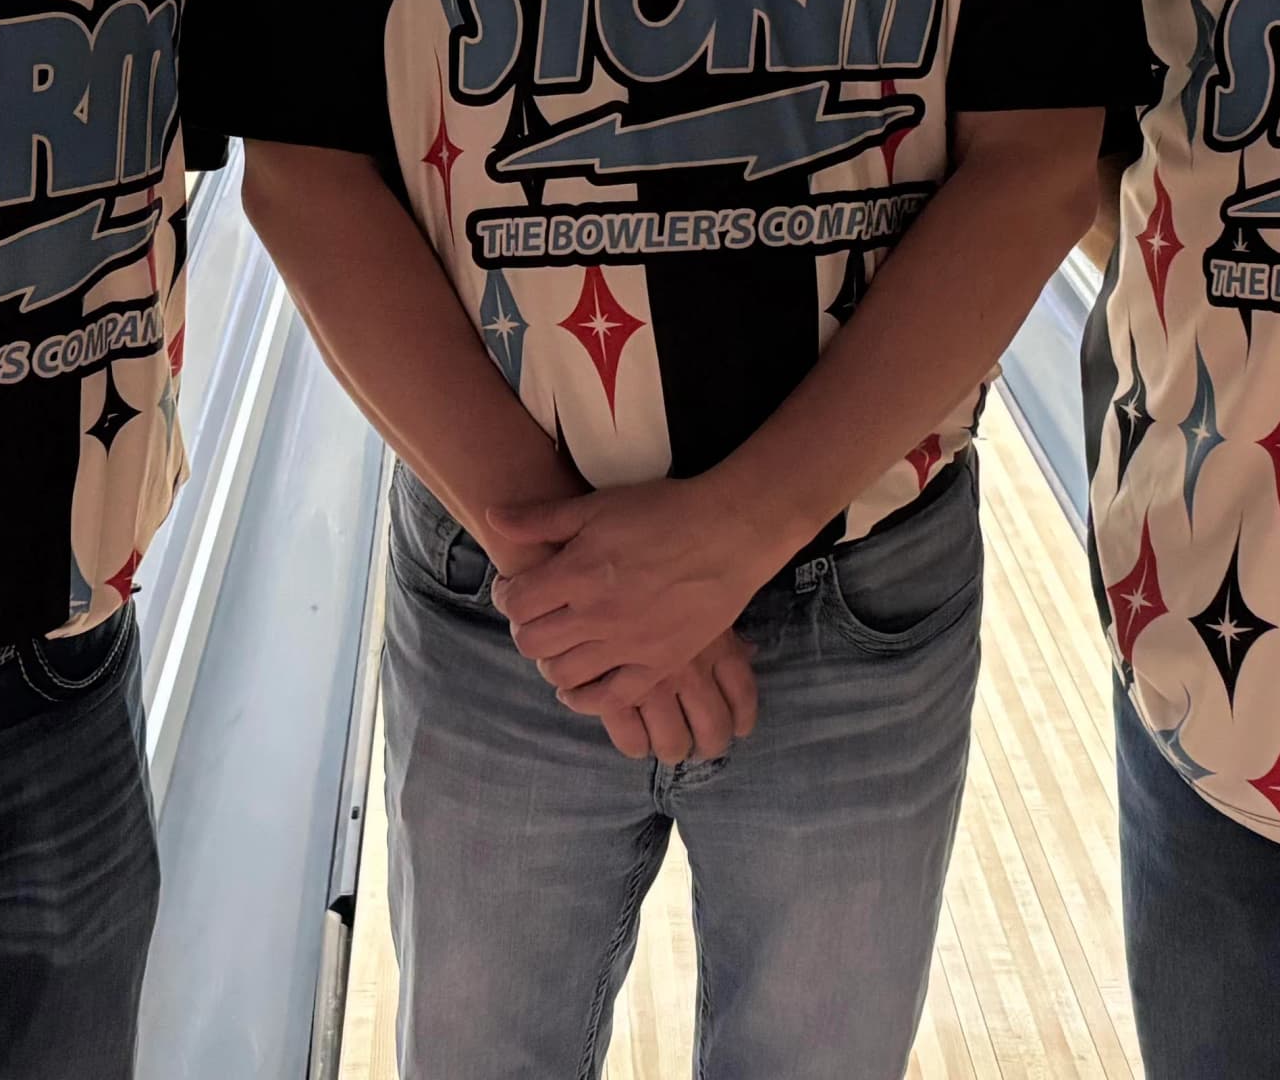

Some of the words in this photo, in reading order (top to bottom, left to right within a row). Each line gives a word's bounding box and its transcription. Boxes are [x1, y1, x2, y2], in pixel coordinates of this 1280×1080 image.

[478, 218, 545, 257] THE
[550, 209, 754, 254] BOWLER'S
[1211, 260, 1268, 299] THE
[34, 303, 162, 377] COMPAN
